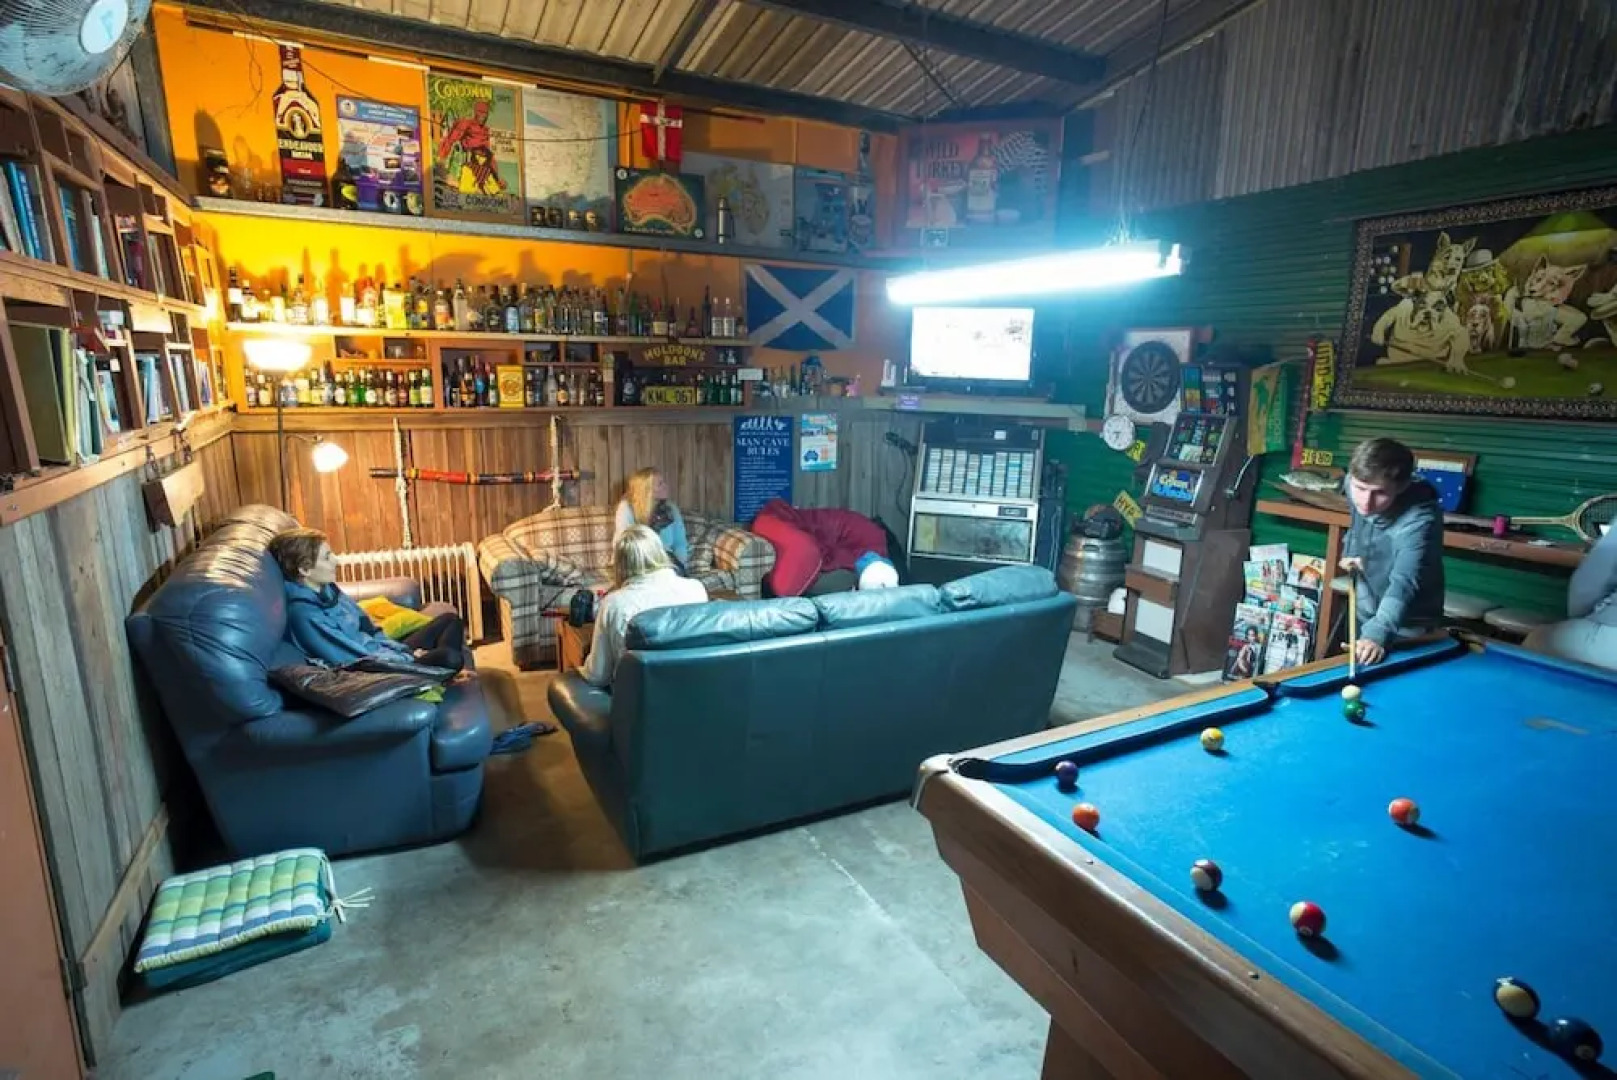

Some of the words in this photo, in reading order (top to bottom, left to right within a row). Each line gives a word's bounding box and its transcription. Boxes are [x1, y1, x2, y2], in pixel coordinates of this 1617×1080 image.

[664, 355, 687, 366] BAR
[737, 438, 761, 447] MAN
[762, 437, 790, 447] CAVE
[746, 447, 781, 456] RULES
